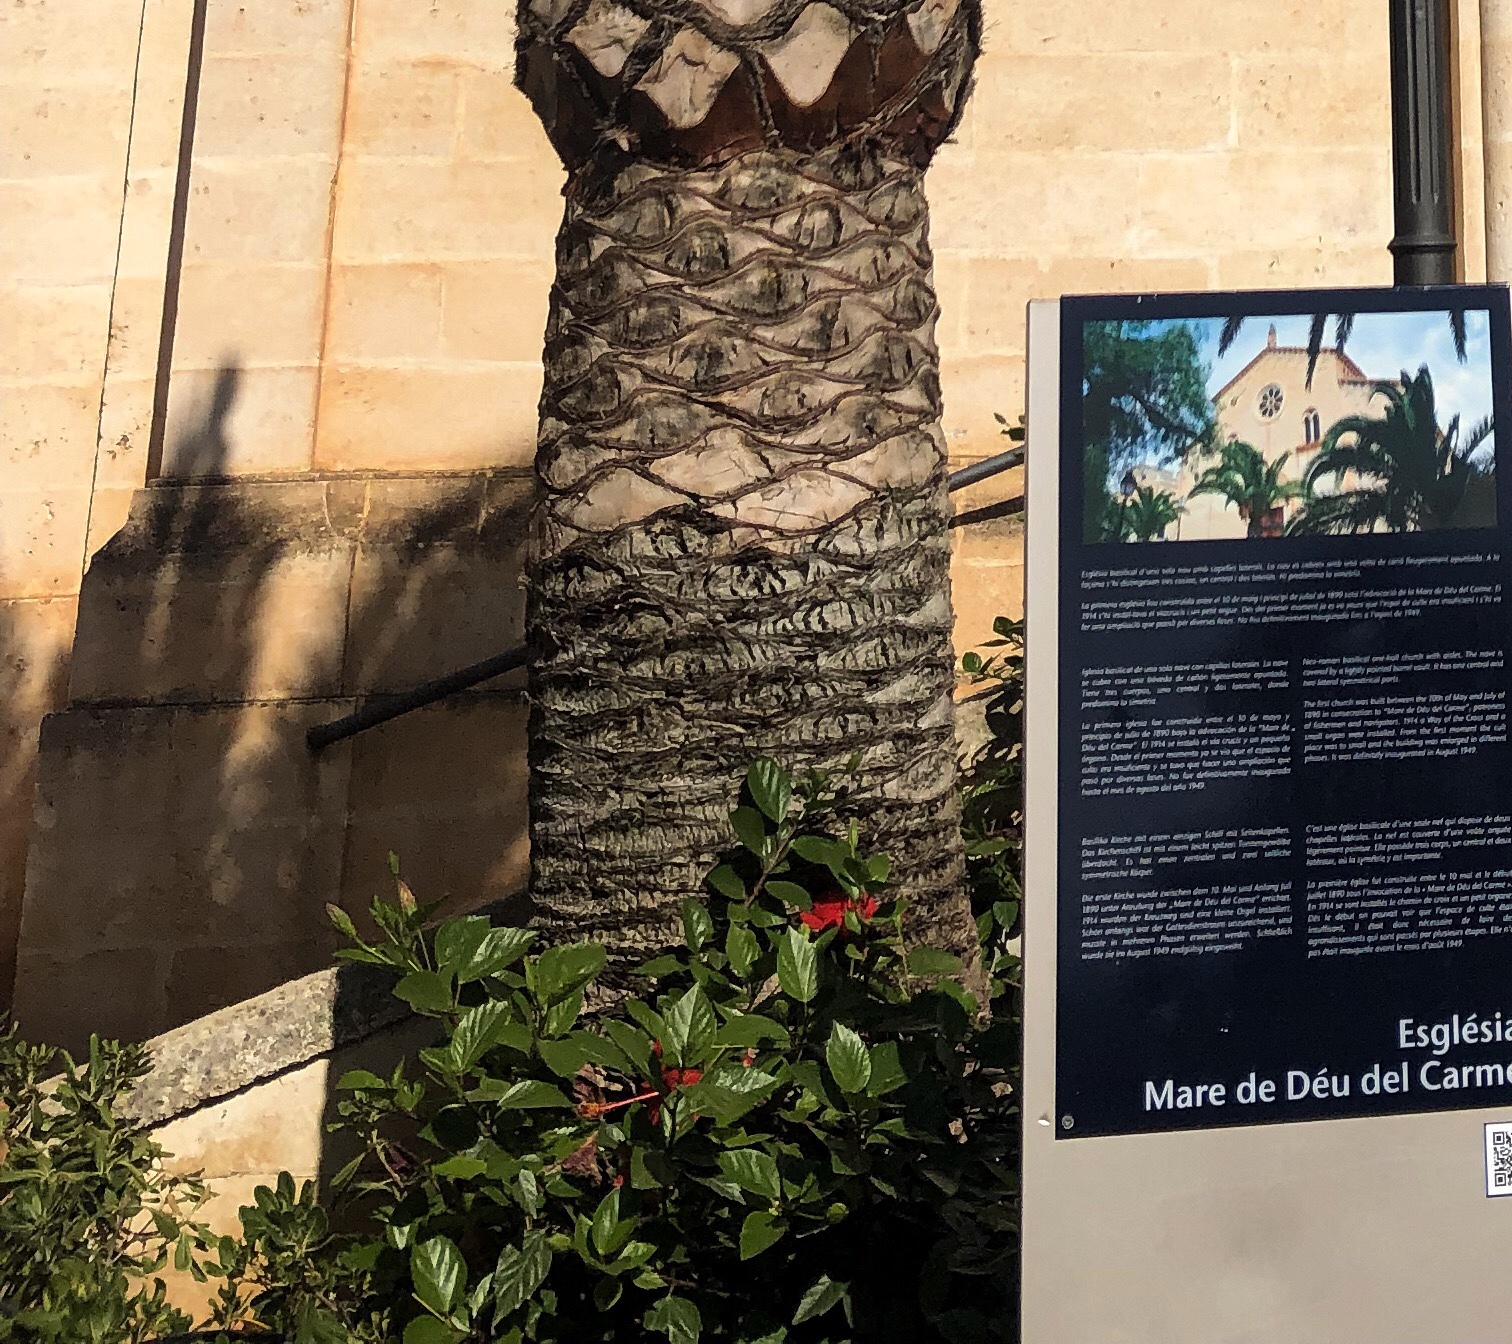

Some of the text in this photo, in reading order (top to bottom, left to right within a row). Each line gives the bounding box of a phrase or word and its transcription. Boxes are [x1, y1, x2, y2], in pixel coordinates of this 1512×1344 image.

[1145, 1078, 1226, 1112] Mare
[1236, 1071, 1276, 1104] de
[1287, 1066, 1350, 1101] Déu
[1360, 1060, 1409, 1095] del
